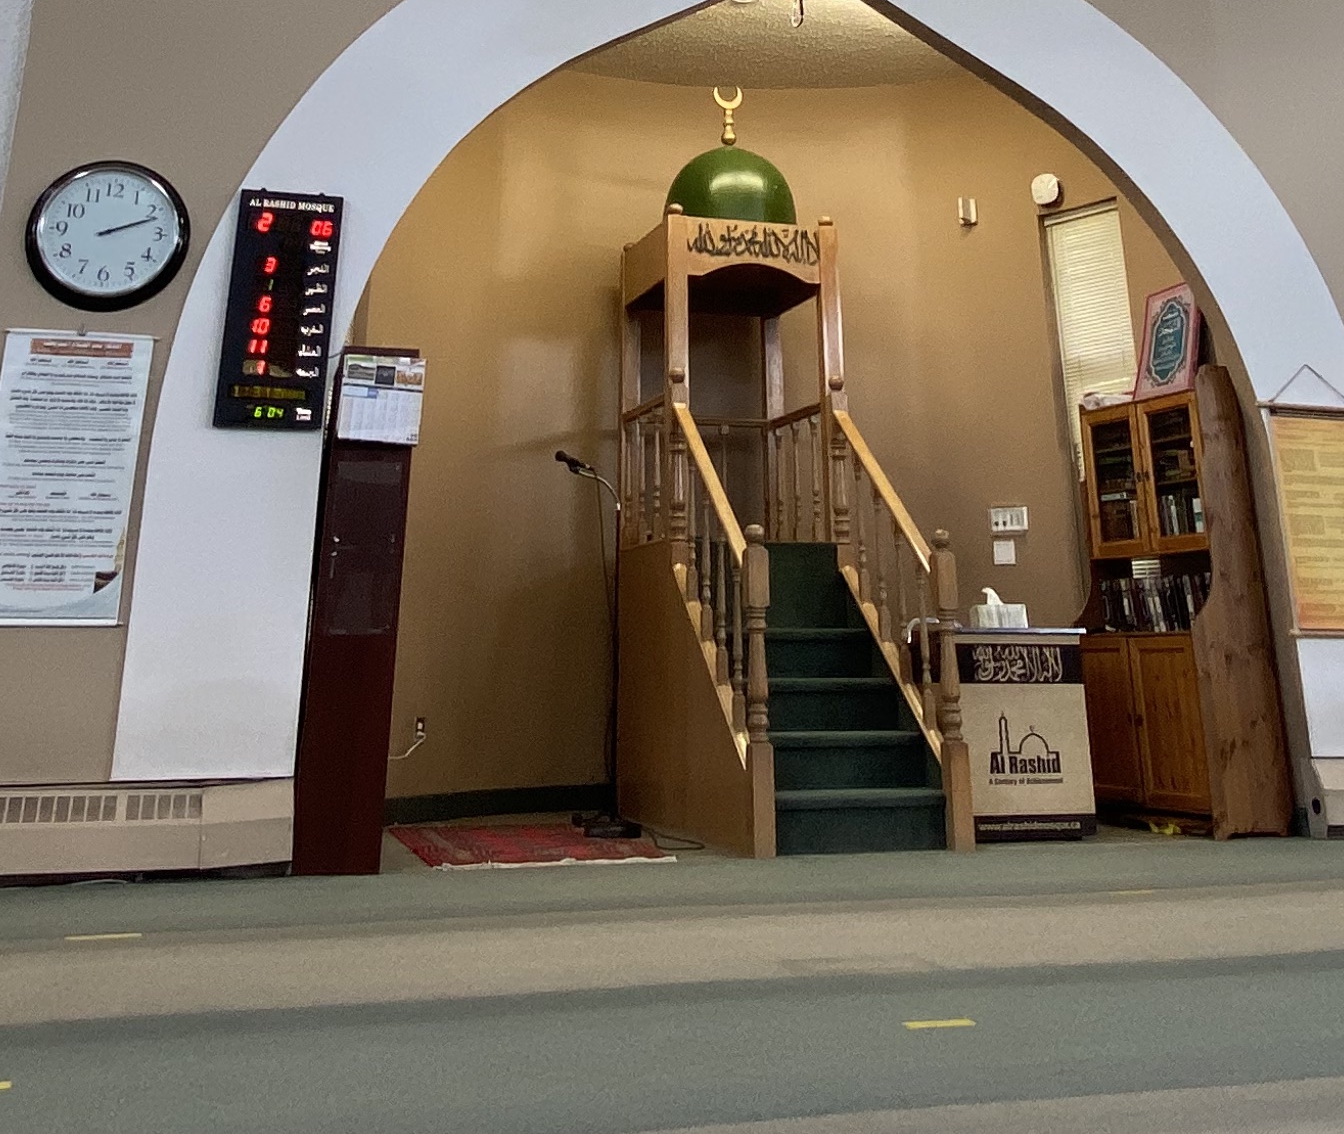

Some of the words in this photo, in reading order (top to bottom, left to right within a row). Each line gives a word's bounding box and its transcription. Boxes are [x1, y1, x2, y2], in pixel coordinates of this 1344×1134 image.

[86, 188, 100, 203] 11
[106, 183, 124, 198] 12
[67, 203, 85, 218] 10
[146, 204, 157, 218] 2
[249, 198, 261, 207] AL
[263, 199, 296, 210] RASHID
[298, 202, 335, 213] MOSQUE
[56, 221, 68, 236] 9
[257, 212, 274, 232] 2
[310, 220, 333, 236] 06
[153, 227, 164, 241] 3
[59, 243, 72, 258] 8
[141, 247, 152, 262] 4
[78, 259, 89, 274] 7
[124, 262, 135, 281] 5
[264, 256, 277, 273] 3
[97, 266, 110, 282] 6
[258, 296, 272, 313] 6
[248, 339, 268, 354] 11
[990, 752, 1006, 774] Al
[1009, 752, 1061, 774] Rashid
